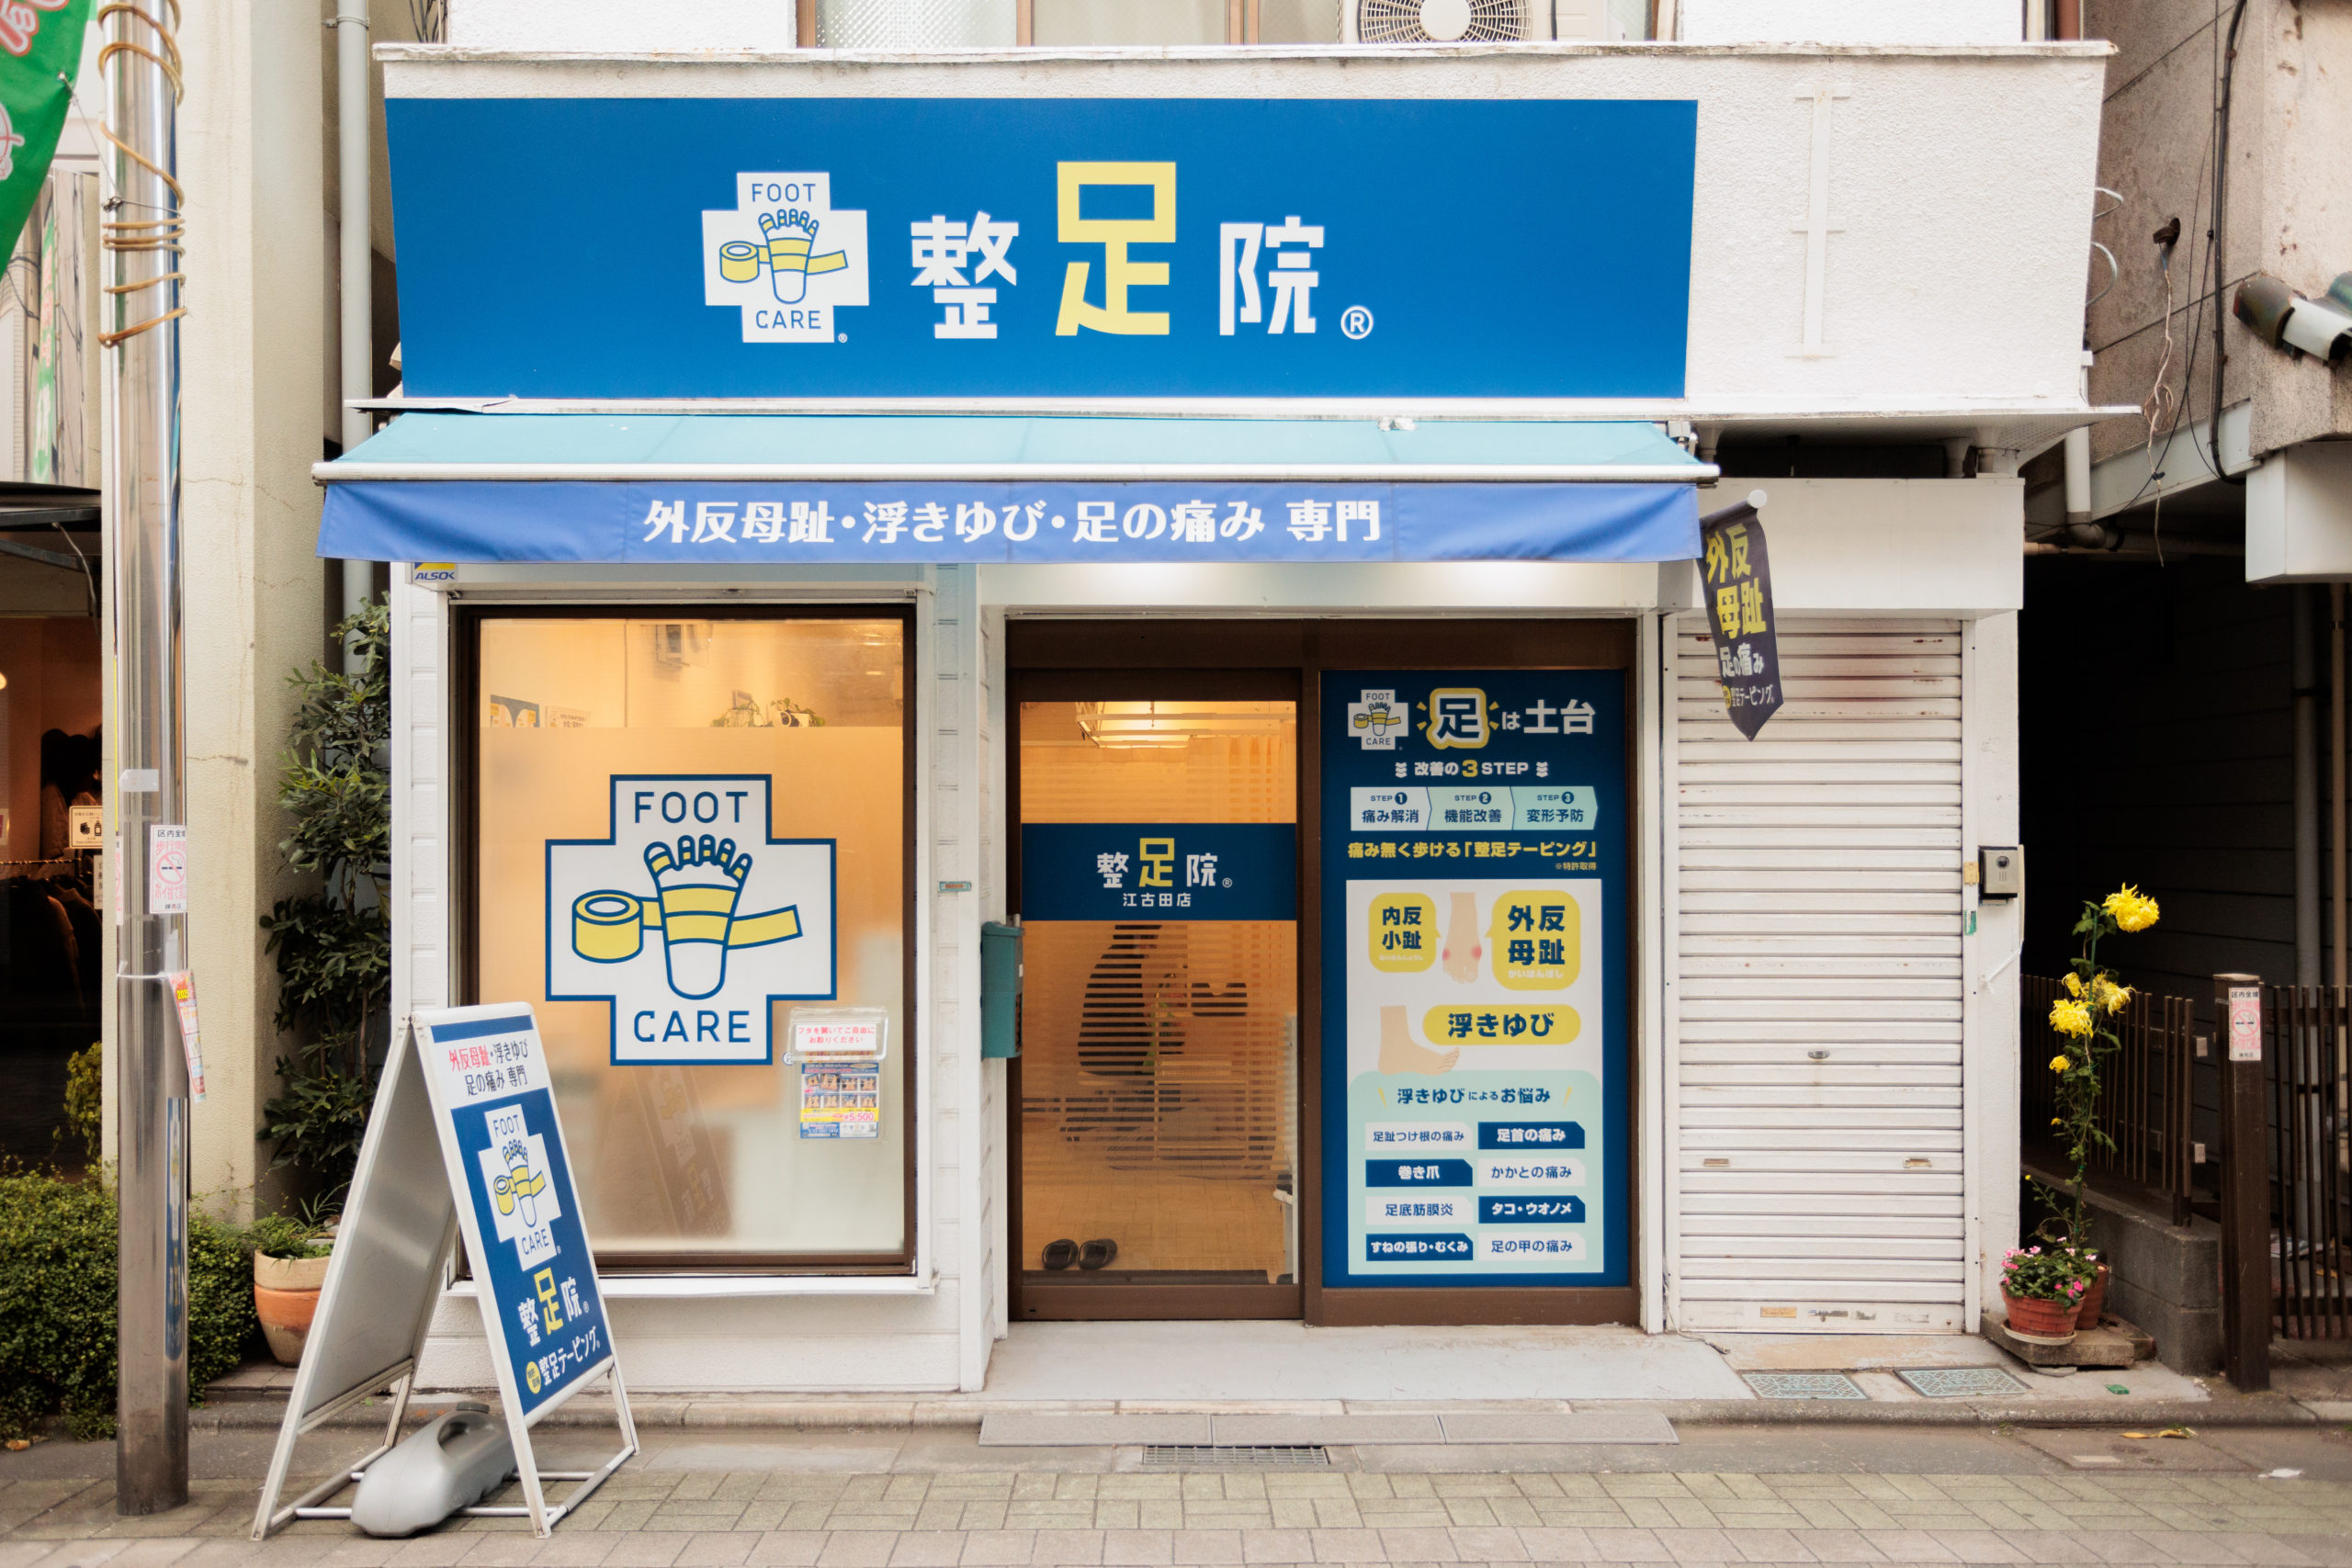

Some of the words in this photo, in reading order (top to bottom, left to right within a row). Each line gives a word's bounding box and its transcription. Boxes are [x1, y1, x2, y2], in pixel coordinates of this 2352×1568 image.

[751, 183, 817, 203] FOOT
[755, 310, 822, 330] CARE
[1285, 499, 1382, 543] 専門
[1705, 522, 1752, 584] 外反
[414, 571, 456, 581] ALSOK
[1715, 577, 1767, 639] 母趾
[1719, 642, 1764, 678] 足の痛み
[1365, 692, 1391, 701] FOOT
[1365, 736, 1392, 746] CARE
[634, 791, 750, 824] FOOT
[1362, 808, 1419, 823] 痛み解消
[1444, 808, 1502, 823] 機能改善
[1526, 808, 1584, 823] 変形予防
[1122, 892, 1192, 908] 江古田店
[1382, 906, 1422, 926] 内反
[1508, 905, 1566, 932] 外反
[1382, 931, 1422, 950] 小趾
[1508, 939, 1566, 965] 母趾
[634, 1010, 751, 1043] CARE
[1448, 1012, 1555, 1038] 浮きゆび
[465, 1069, 504, 1097] 足の痛み
[507, 1065, 528, 1088] 専門
[1396, 1087, 1551, 1104] 浮きゆびによるお悩み
[492, 1114, 520, 1138] FOOT
[1496, 1128, 1566, 1143] 足首の痛み
[1373, 1131, 1464, 1143] 足趾つけ根の痛み
[1397, 1165, 1441, 1180] 巻き爪
[1490, 1166, 1572, 1179] かかとの痛み
[1385, 1203, 1454, 1217] 足底筋膜炎
[521, 1228, 550, 1256] CARE
[1490, 1240, 1573, 1253] 足の甲の痛み
